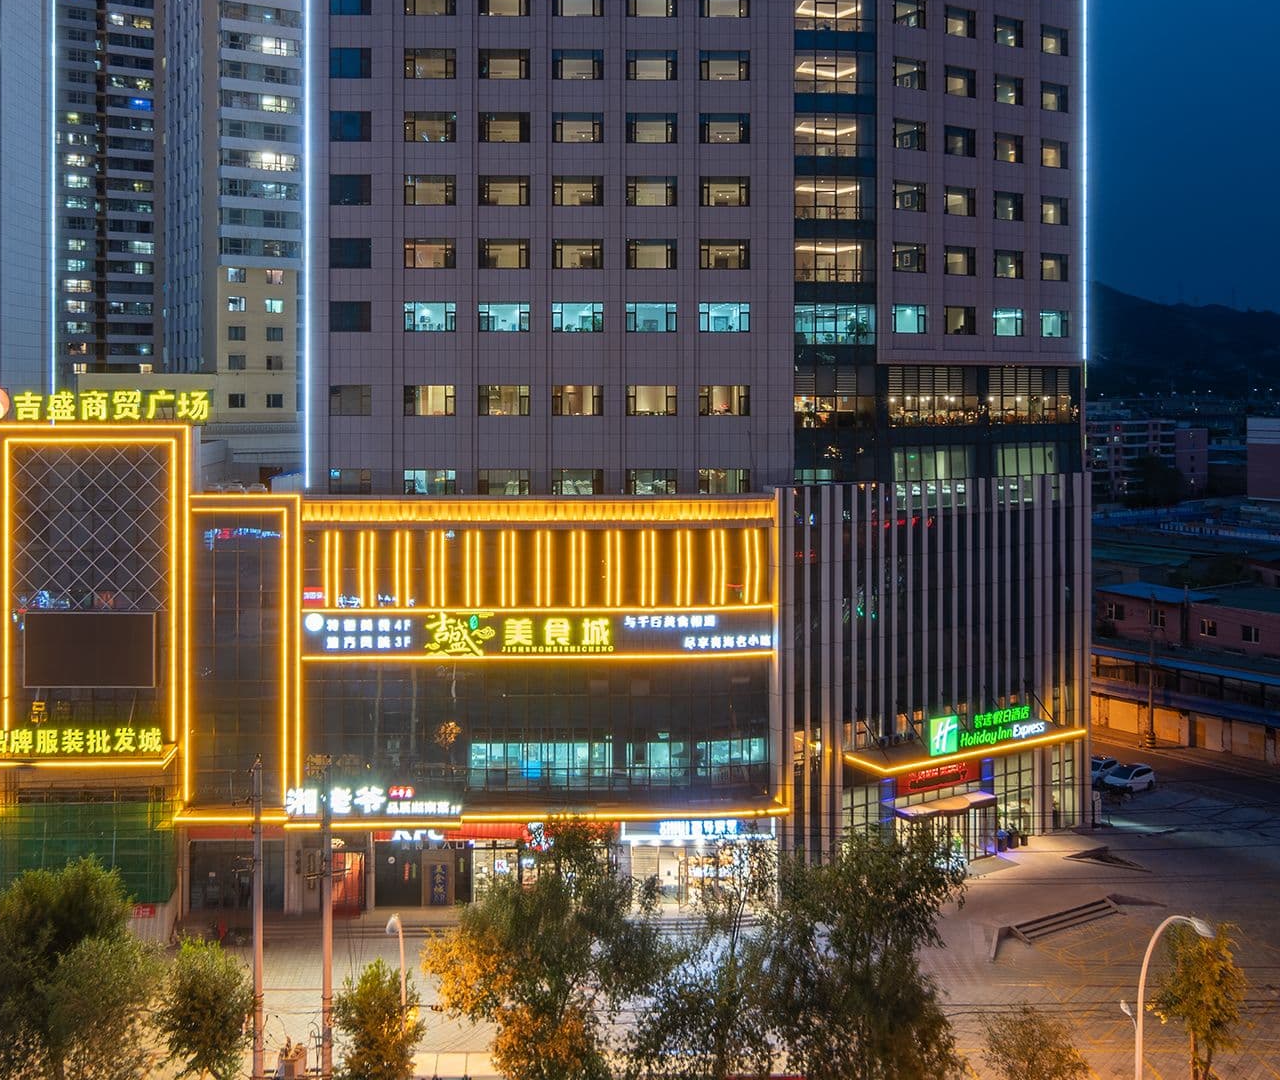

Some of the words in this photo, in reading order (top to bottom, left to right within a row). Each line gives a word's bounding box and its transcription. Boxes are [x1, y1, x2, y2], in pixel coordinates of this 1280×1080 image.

[13, 389, 209, 420] 吉盛商贸广场
[504, 617, 610, 645] 美食城
[960, 730, 997, 745] Holiday
[997, 727, 1013, 741] Inn
[1012, 721, 1045, 739] Express
